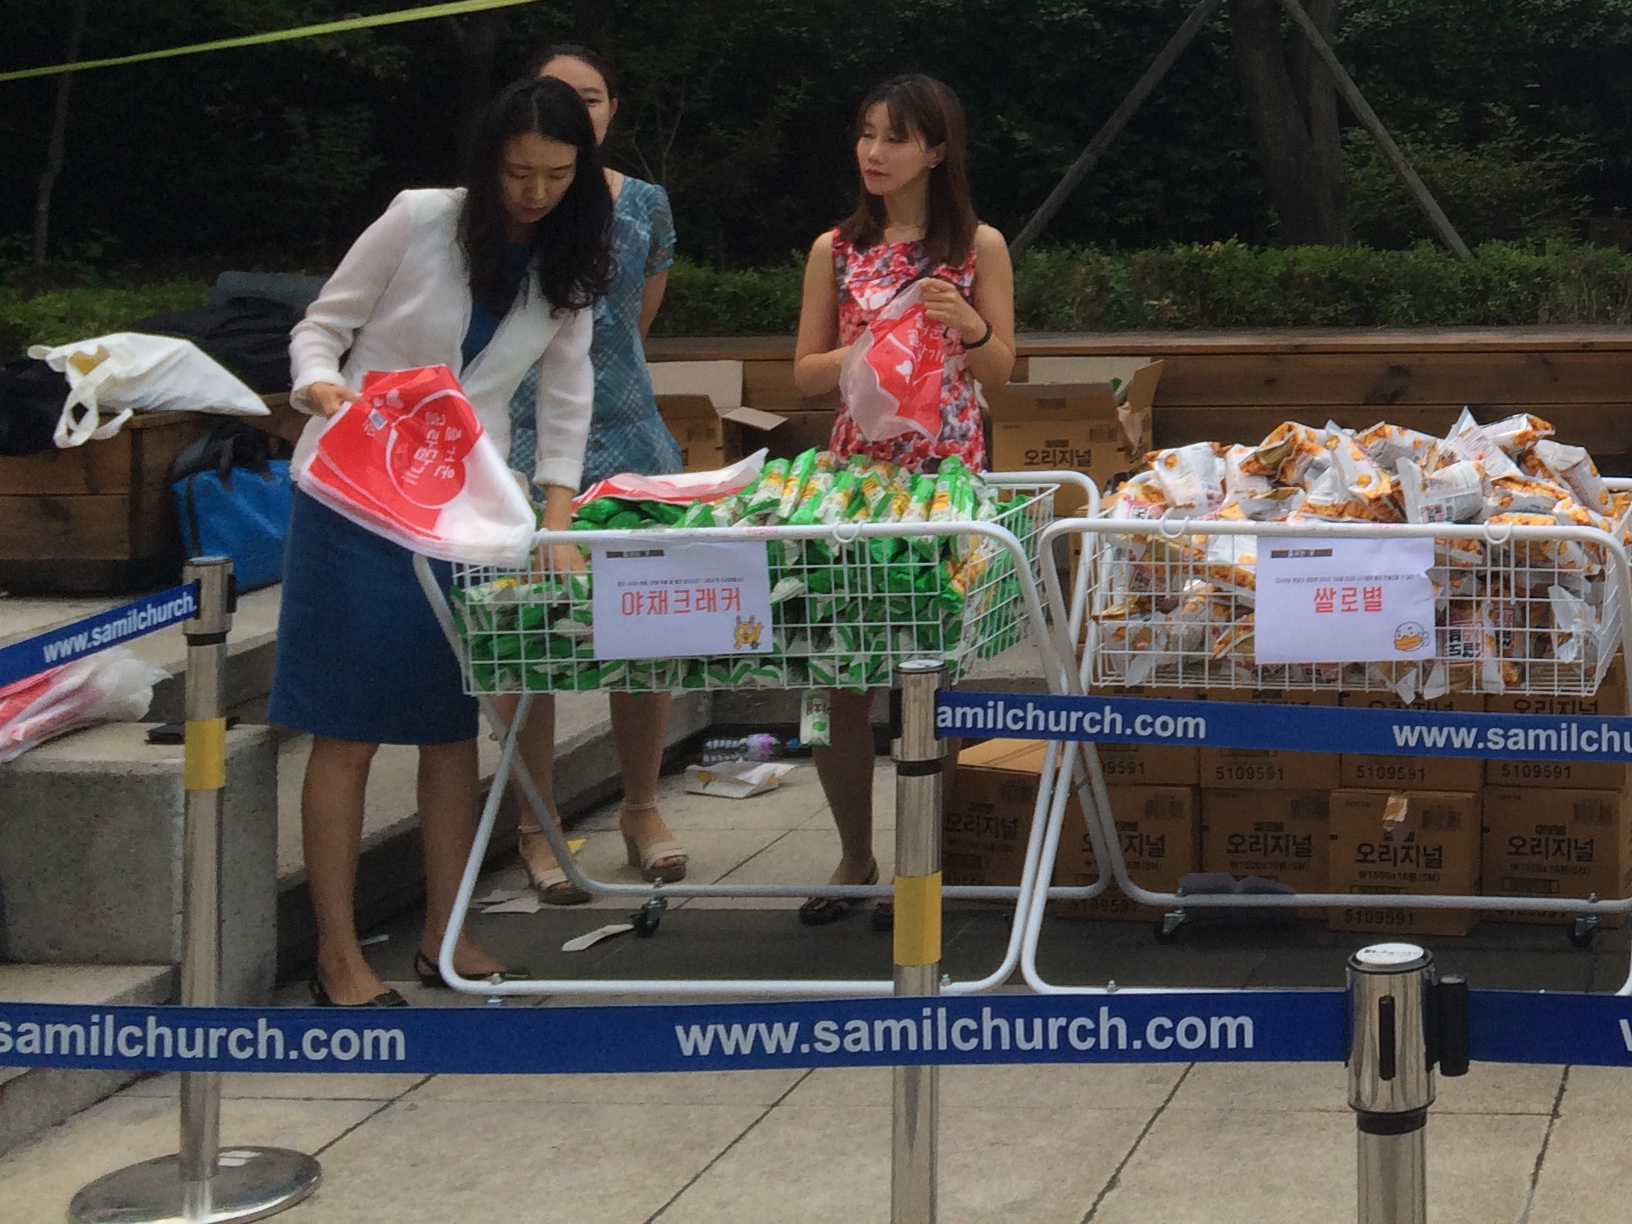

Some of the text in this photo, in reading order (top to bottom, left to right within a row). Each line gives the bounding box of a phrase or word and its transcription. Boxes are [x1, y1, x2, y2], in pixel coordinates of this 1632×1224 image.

[1024, 449, 1092, 468] 오리지널
[611, 587, 742, 616] 야채크래커
[1314, 586, 1383, 613] 쌀로별
[1216, 766, 1284, 780] 5109591
[1357, 765, 1425, 782] 5109591
[1501, 764, 1571, 779] 5109591
[1227, 833, 1312, 858] 오리지널
[1355, 843, 1442, 869] 오리지널
[1507, 835, 1594, 862] 오리지널
[676, 1008, 1254, 1056] www.samilchurch.com
